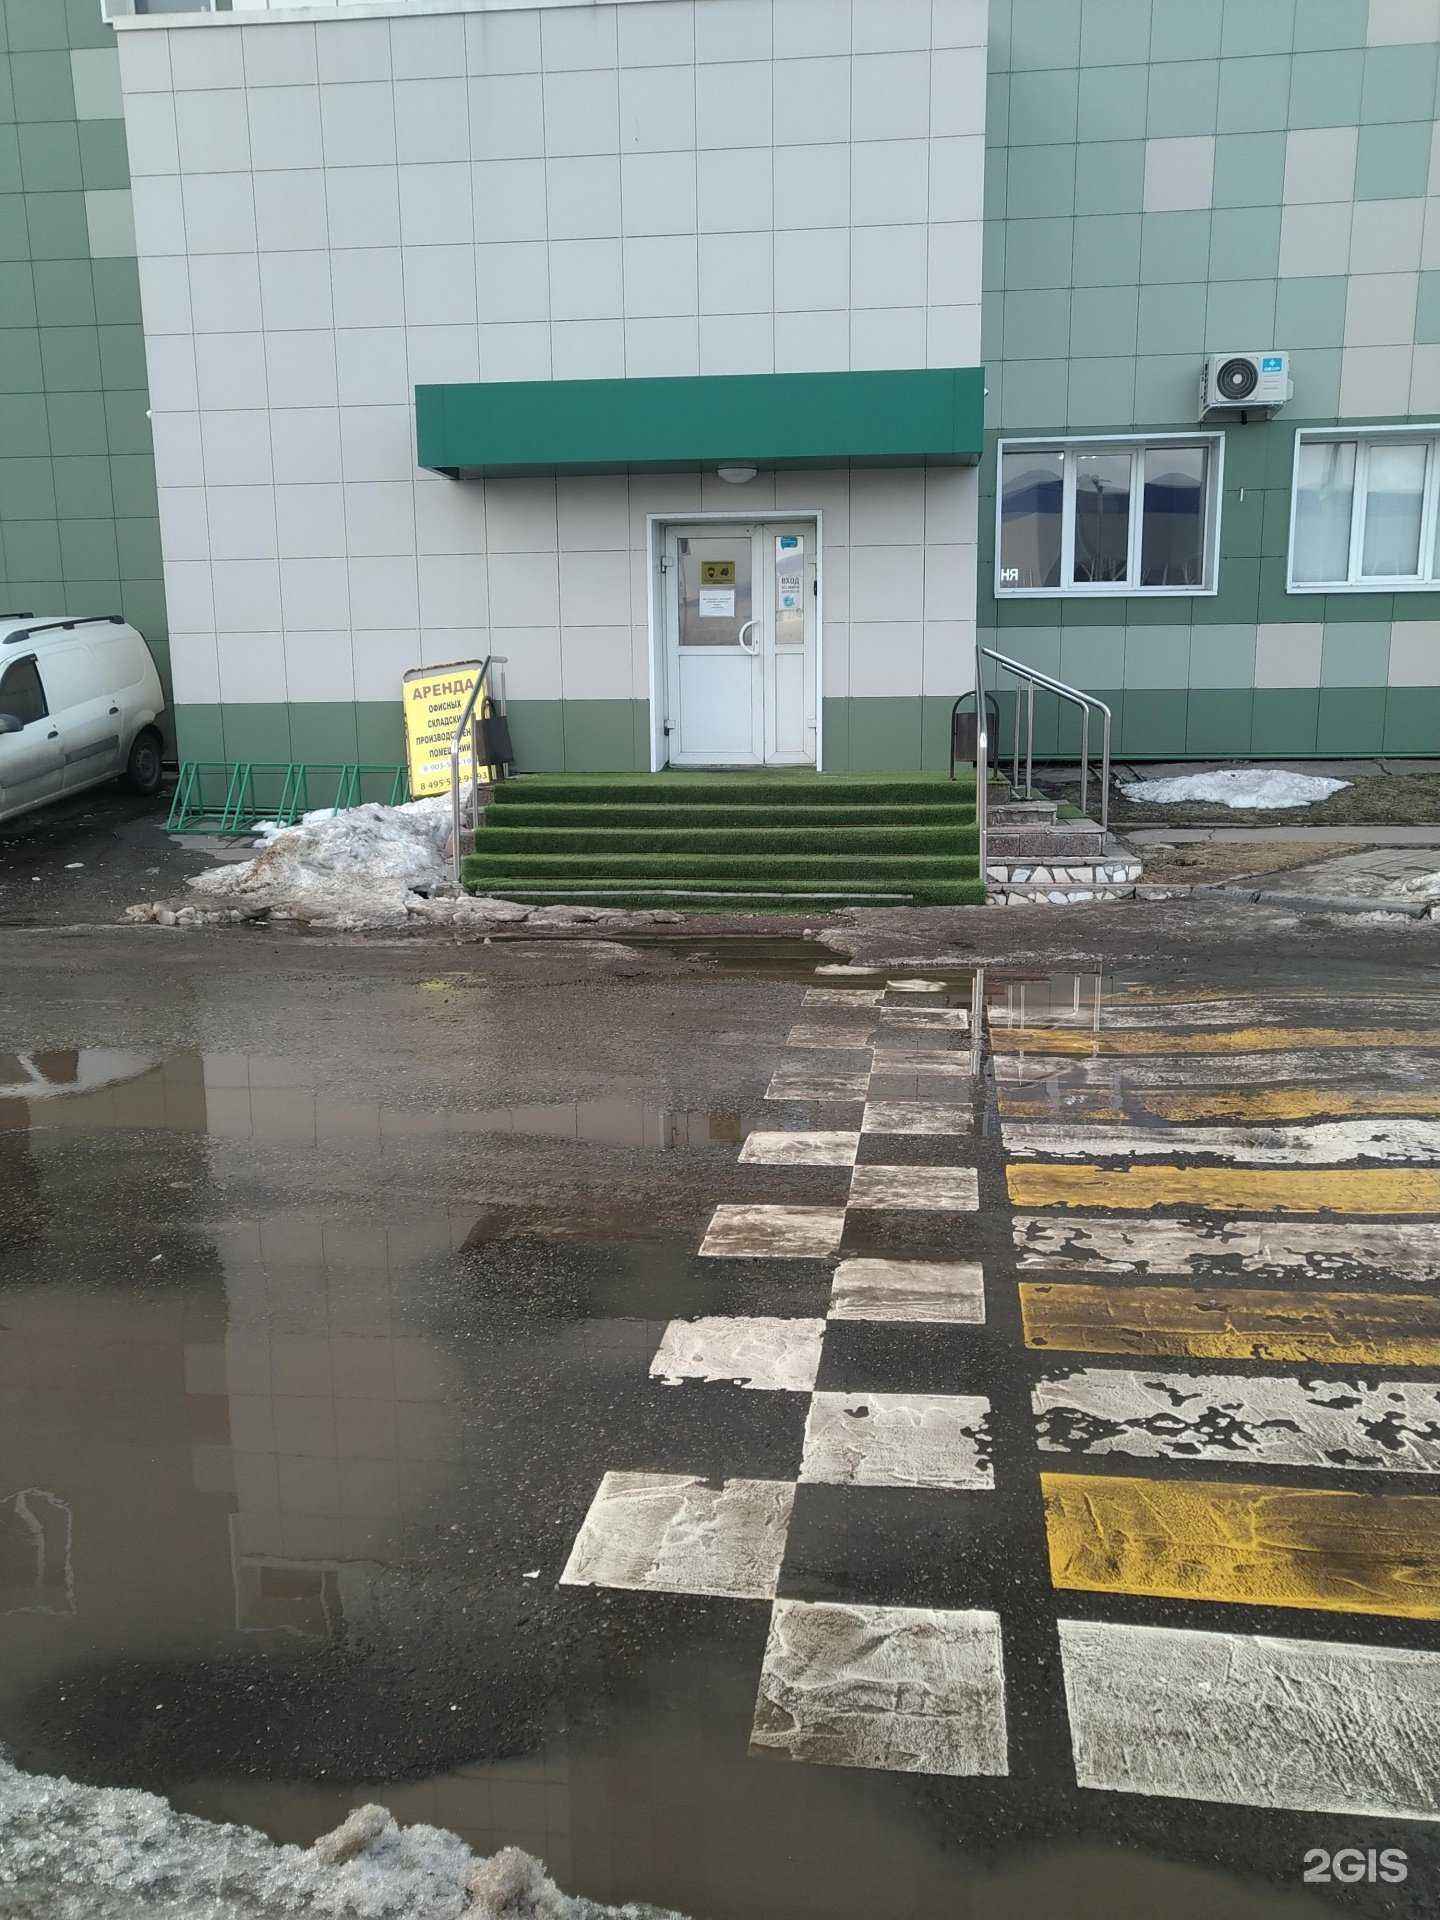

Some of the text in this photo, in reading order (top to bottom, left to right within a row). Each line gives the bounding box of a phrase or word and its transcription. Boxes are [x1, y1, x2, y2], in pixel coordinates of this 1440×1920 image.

[412, 678, 474, 700] АРЕНДА
[428, 700, 462, 713] ОФИСНЫХ
[427, 713, 463, 728] СКЛАДСКИ
